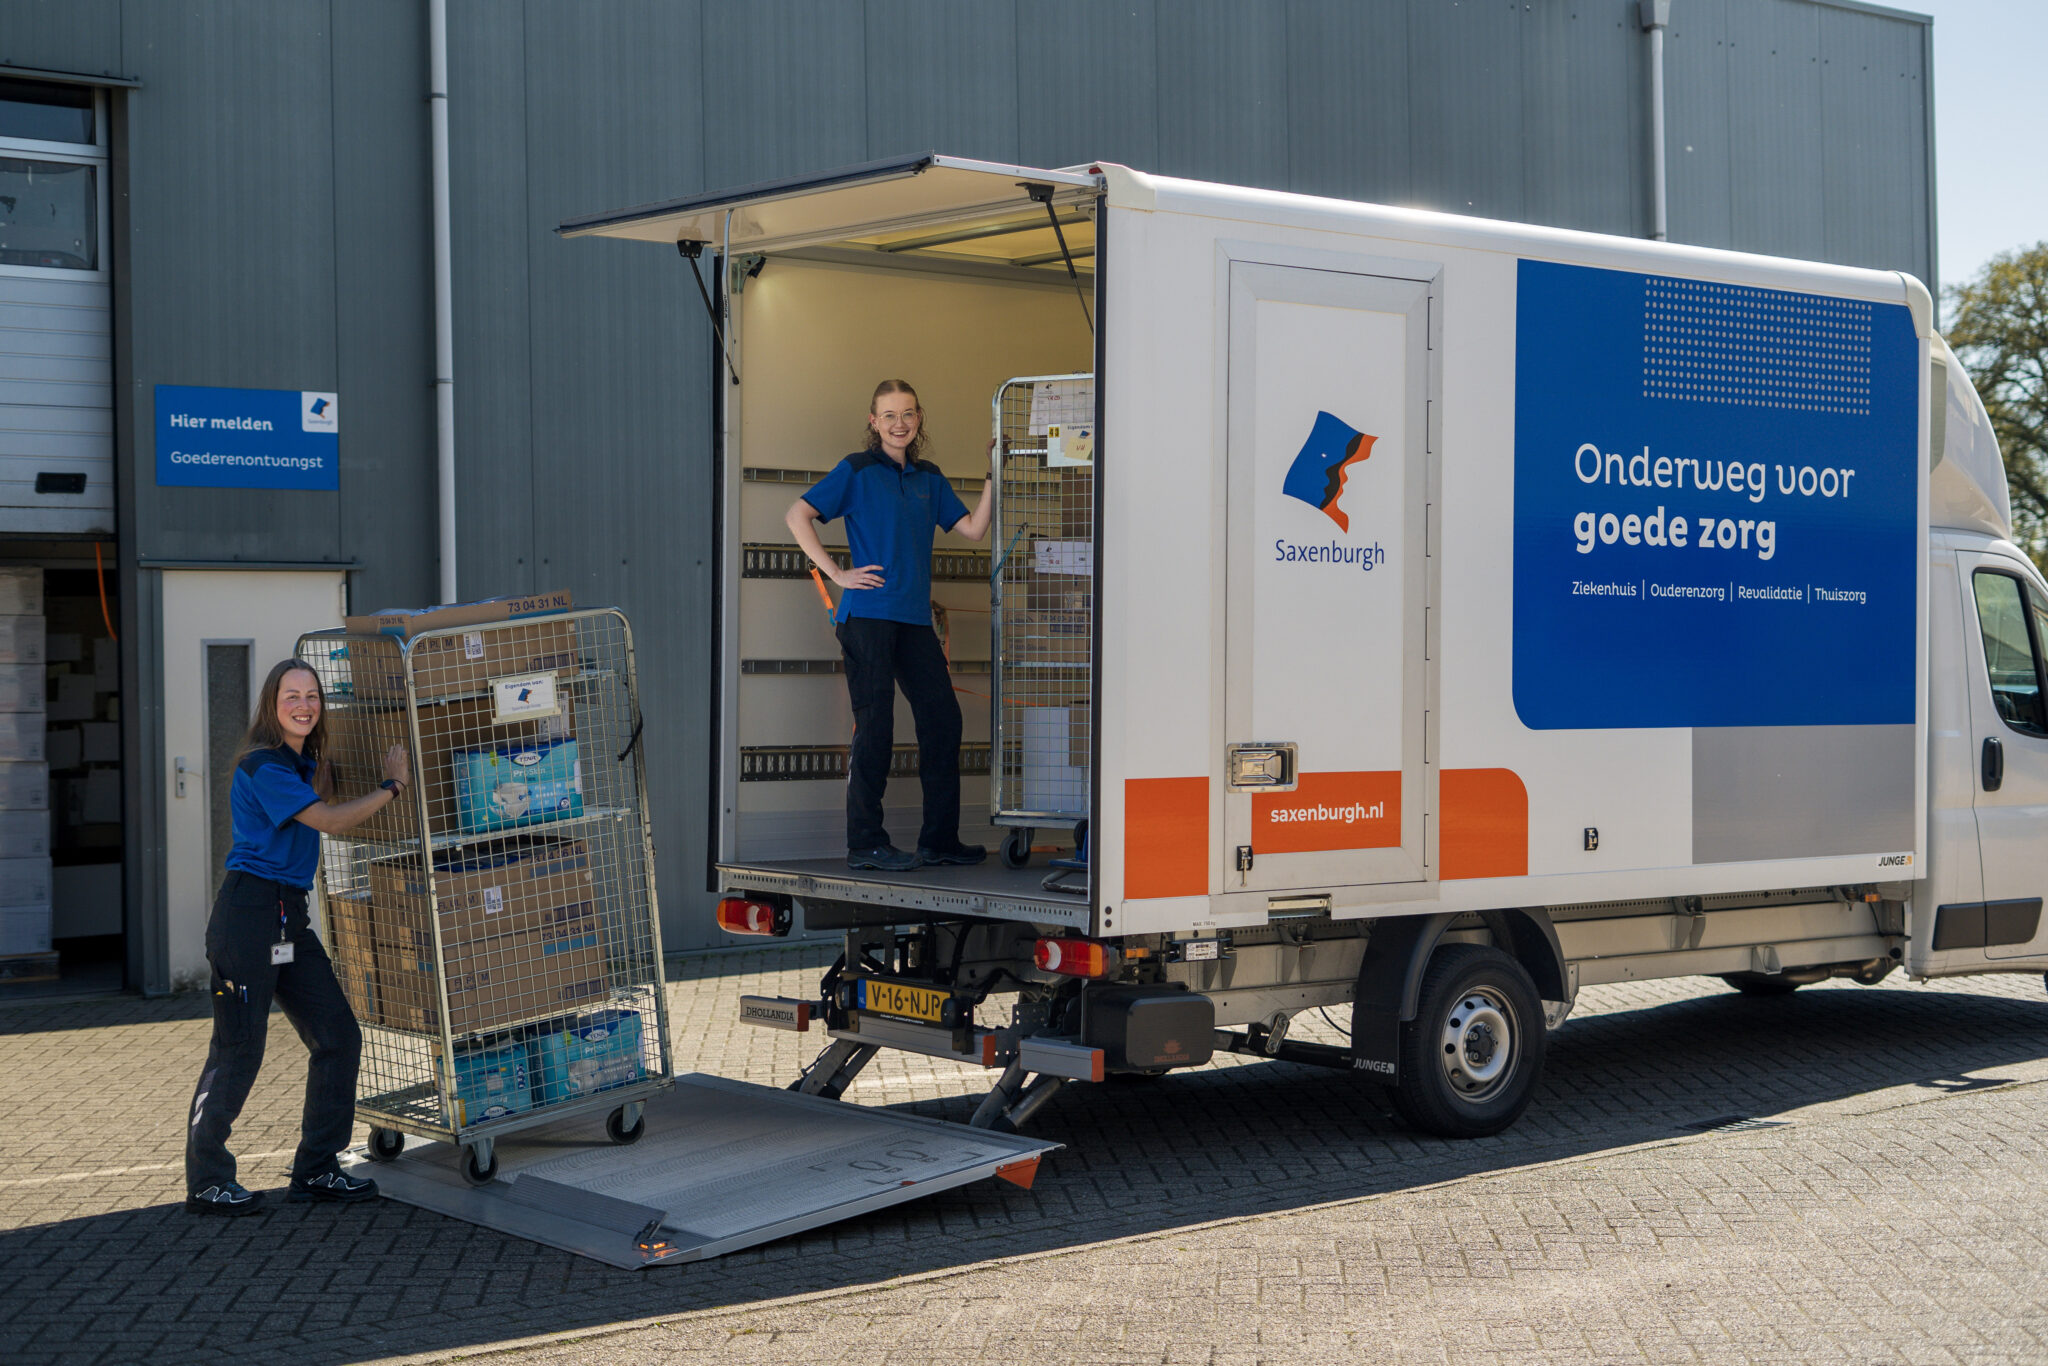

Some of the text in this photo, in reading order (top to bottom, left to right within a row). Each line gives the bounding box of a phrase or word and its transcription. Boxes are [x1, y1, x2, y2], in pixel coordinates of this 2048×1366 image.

[170, 414, 273, 431] Hier melden
[170, 451, 324, 470] Goederenontvangst
[1575, 443, 1855, 503] Onderweg voor
[1573, 505, 1776, 560] goede zorg
[1275, 539, 1385, 571] Saxenburgh
[1572, 580, 1867, 604] Ziekenhuis Ouderenzorg Revalidatie Thuiszorg
[507, 595, 568, 613] 73 04 31 NL
[1270, 801, 1384, 823] saxenburgh.nl
[1878, 855, 1906, 867] JUNGE
[871, 984, 941, 1017] V-16-NJP
[746, 1006, 795, 1022] DHOLLANDIA
[1353, 1058, 1386, 1073] JUNGE
